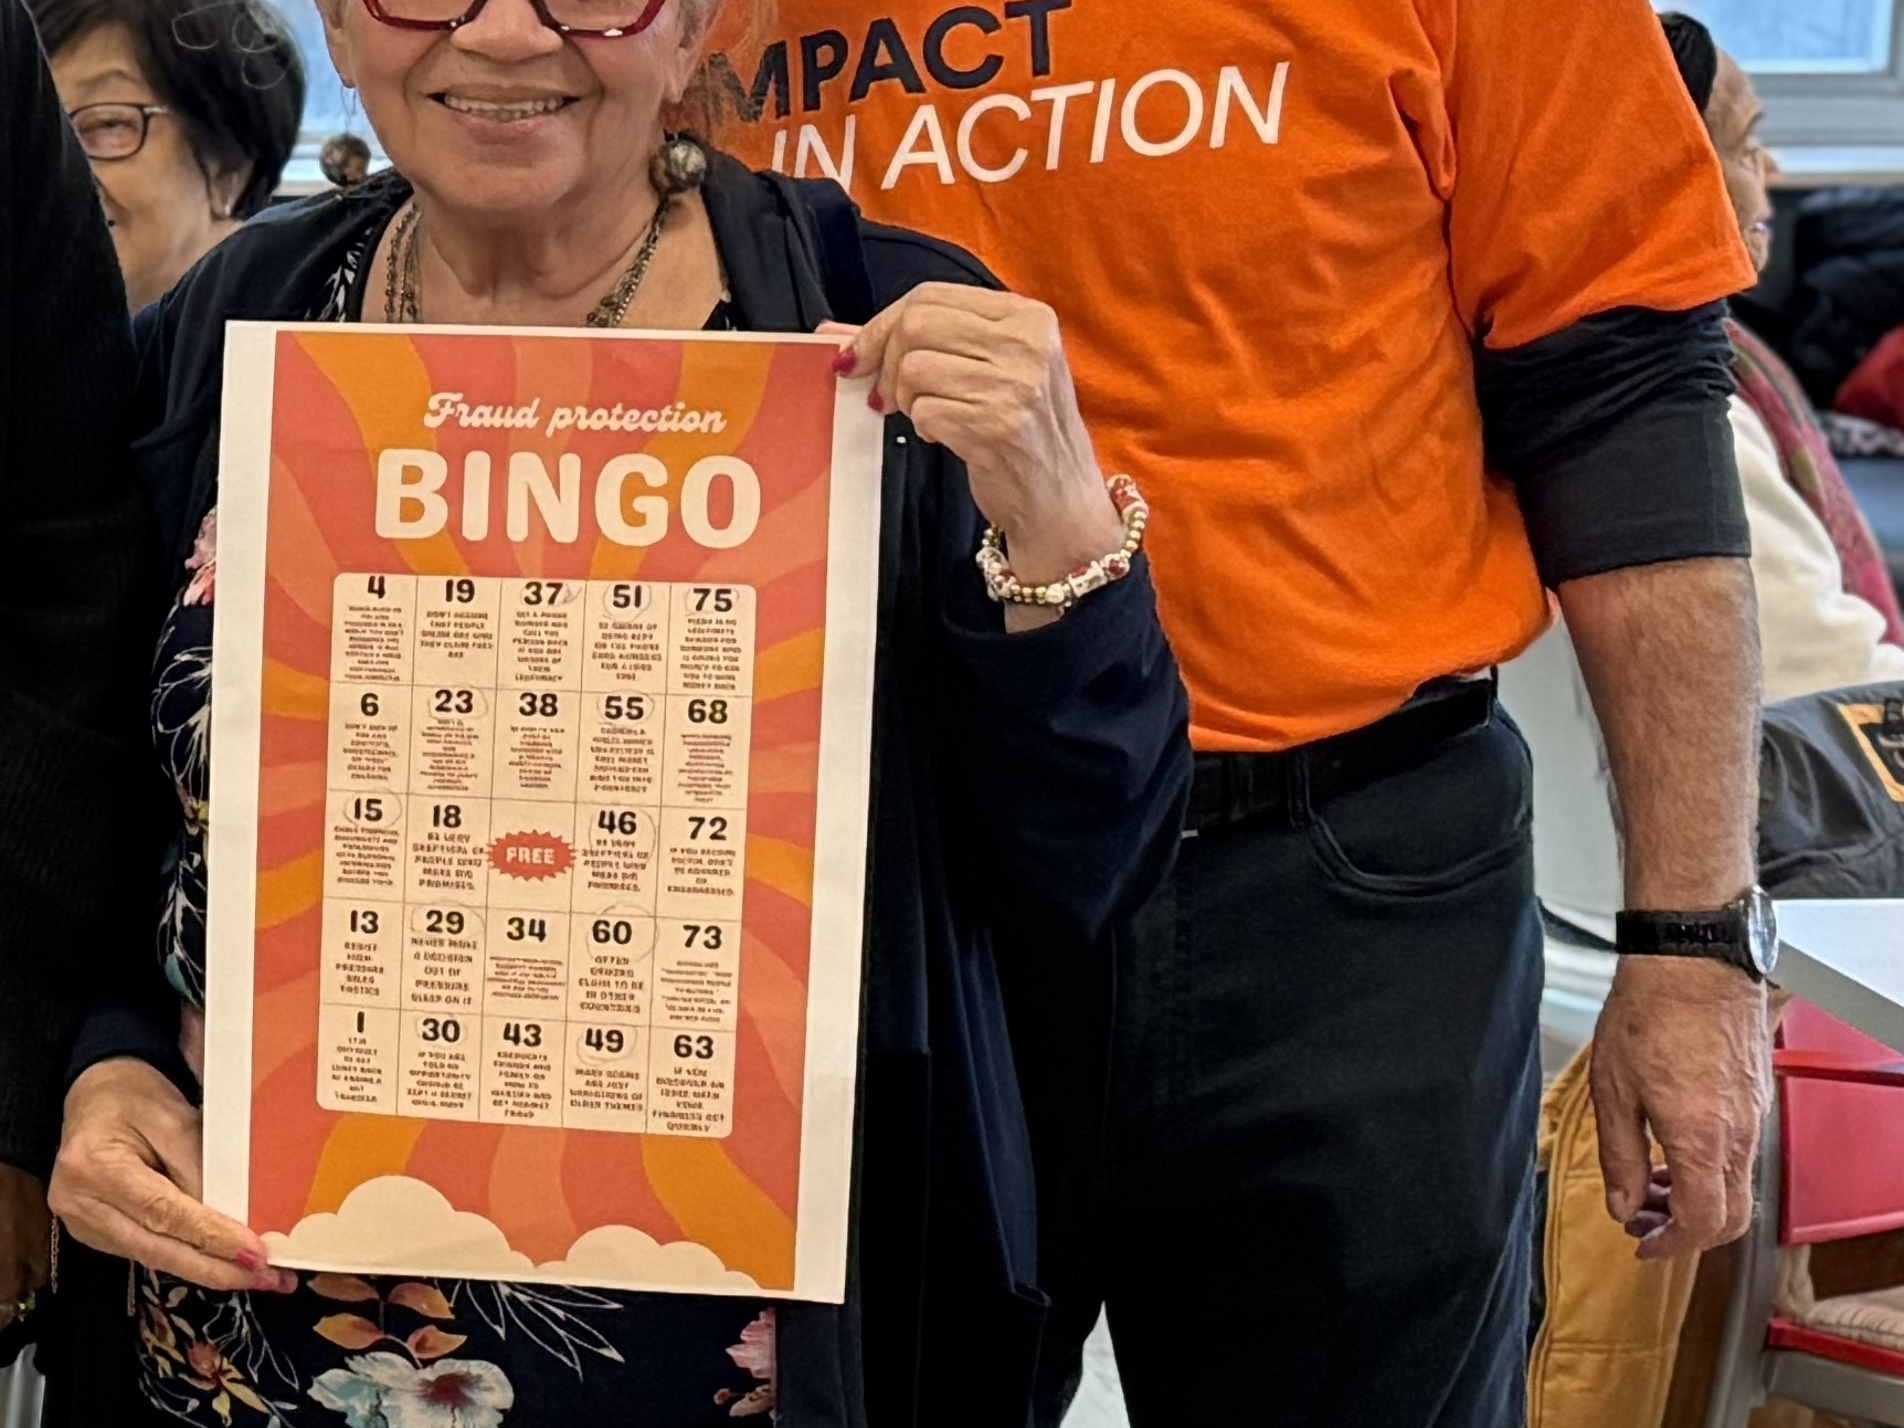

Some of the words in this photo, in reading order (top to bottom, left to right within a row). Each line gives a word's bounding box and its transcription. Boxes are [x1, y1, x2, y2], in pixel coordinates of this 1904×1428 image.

[771, 113, 856, 196] IN
[880, 60, 1291, 191] ACTION
[423, 391, 541, 430] Fraud
[545, 401, 727, 438] protection
[374, 447, 762, 550] BINGO
[367, 575, 386, 599] 4
[445, 579, 475, 603] 19
[524, 581, 563, 606] 37
[612, 584, 642, 609] 51
[693, 588, 733, 612] 75
[360, 692, 379, 717] 6
[435, 689, 473, 714] 23
[518, 692, 558, 717] 38
[604, 695, 644, 720] 55
[688, 699, 728, 724] 68
[354, 798, 383, 822] 15
[433, 804, 462, 829] 18
[598, 810, 637, 835] 46
[688, 816, 727, 841] 72
[504, 845, 556, 865] FREE
[350, 910, 379, 934] 13
[426, 909, 465, 935] 29
[506, 917, 547, 942] 34
[592, 919, 632, 945] 60
[683, 924, 722, 950] 73
[356, 1011, 365, 1034] 1
[422, 1018, 460, 1043] 30
[503, 1022, 542, 1047] 43
[585, 1028, 624, 1053] 49
[673, 1034, 714, 1060] 63
